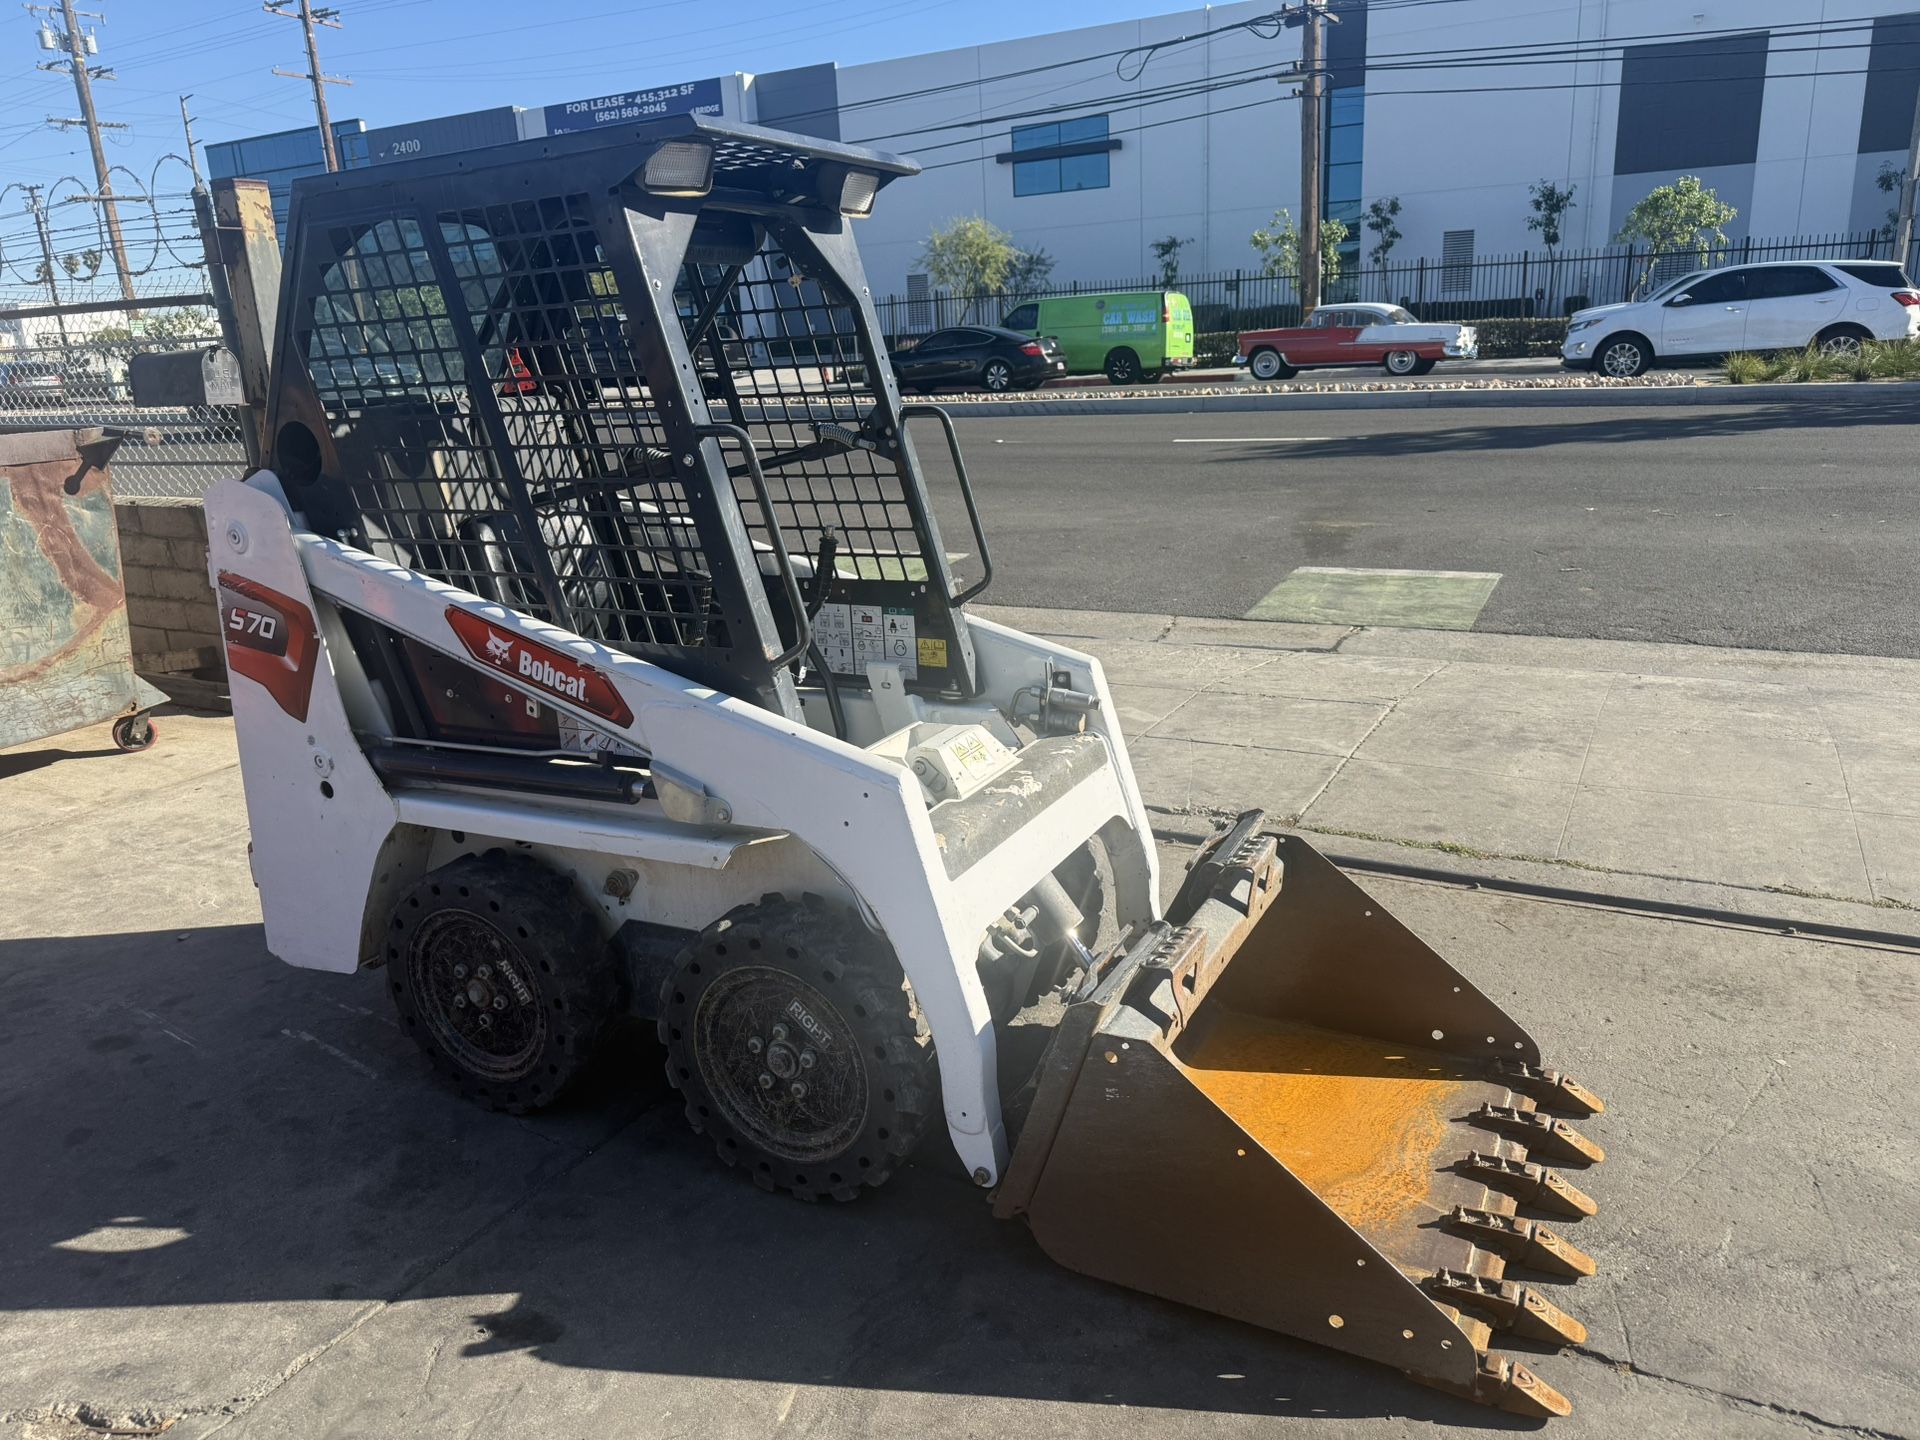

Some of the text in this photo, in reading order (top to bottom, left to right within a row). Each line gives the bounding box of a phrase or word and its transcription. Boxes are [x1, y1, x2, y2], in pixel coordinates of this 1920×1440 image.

[566, 102, 589, 114] FOR
[591, 95, 625, 111] LEASE
[680, 84, 695, 95] SF
[595, 102, 667, 123] (562) 568-2045
[392, 139, 421, 156] 2400
[1104, 310, 1157, 325] CAR WASH
[210, 380, 236, 390] MAIL
[229, 610, 277, 640] S70
[519, 649, 587, 702] Bobcat
[789, 1001, 832, 1043] RIGHT
